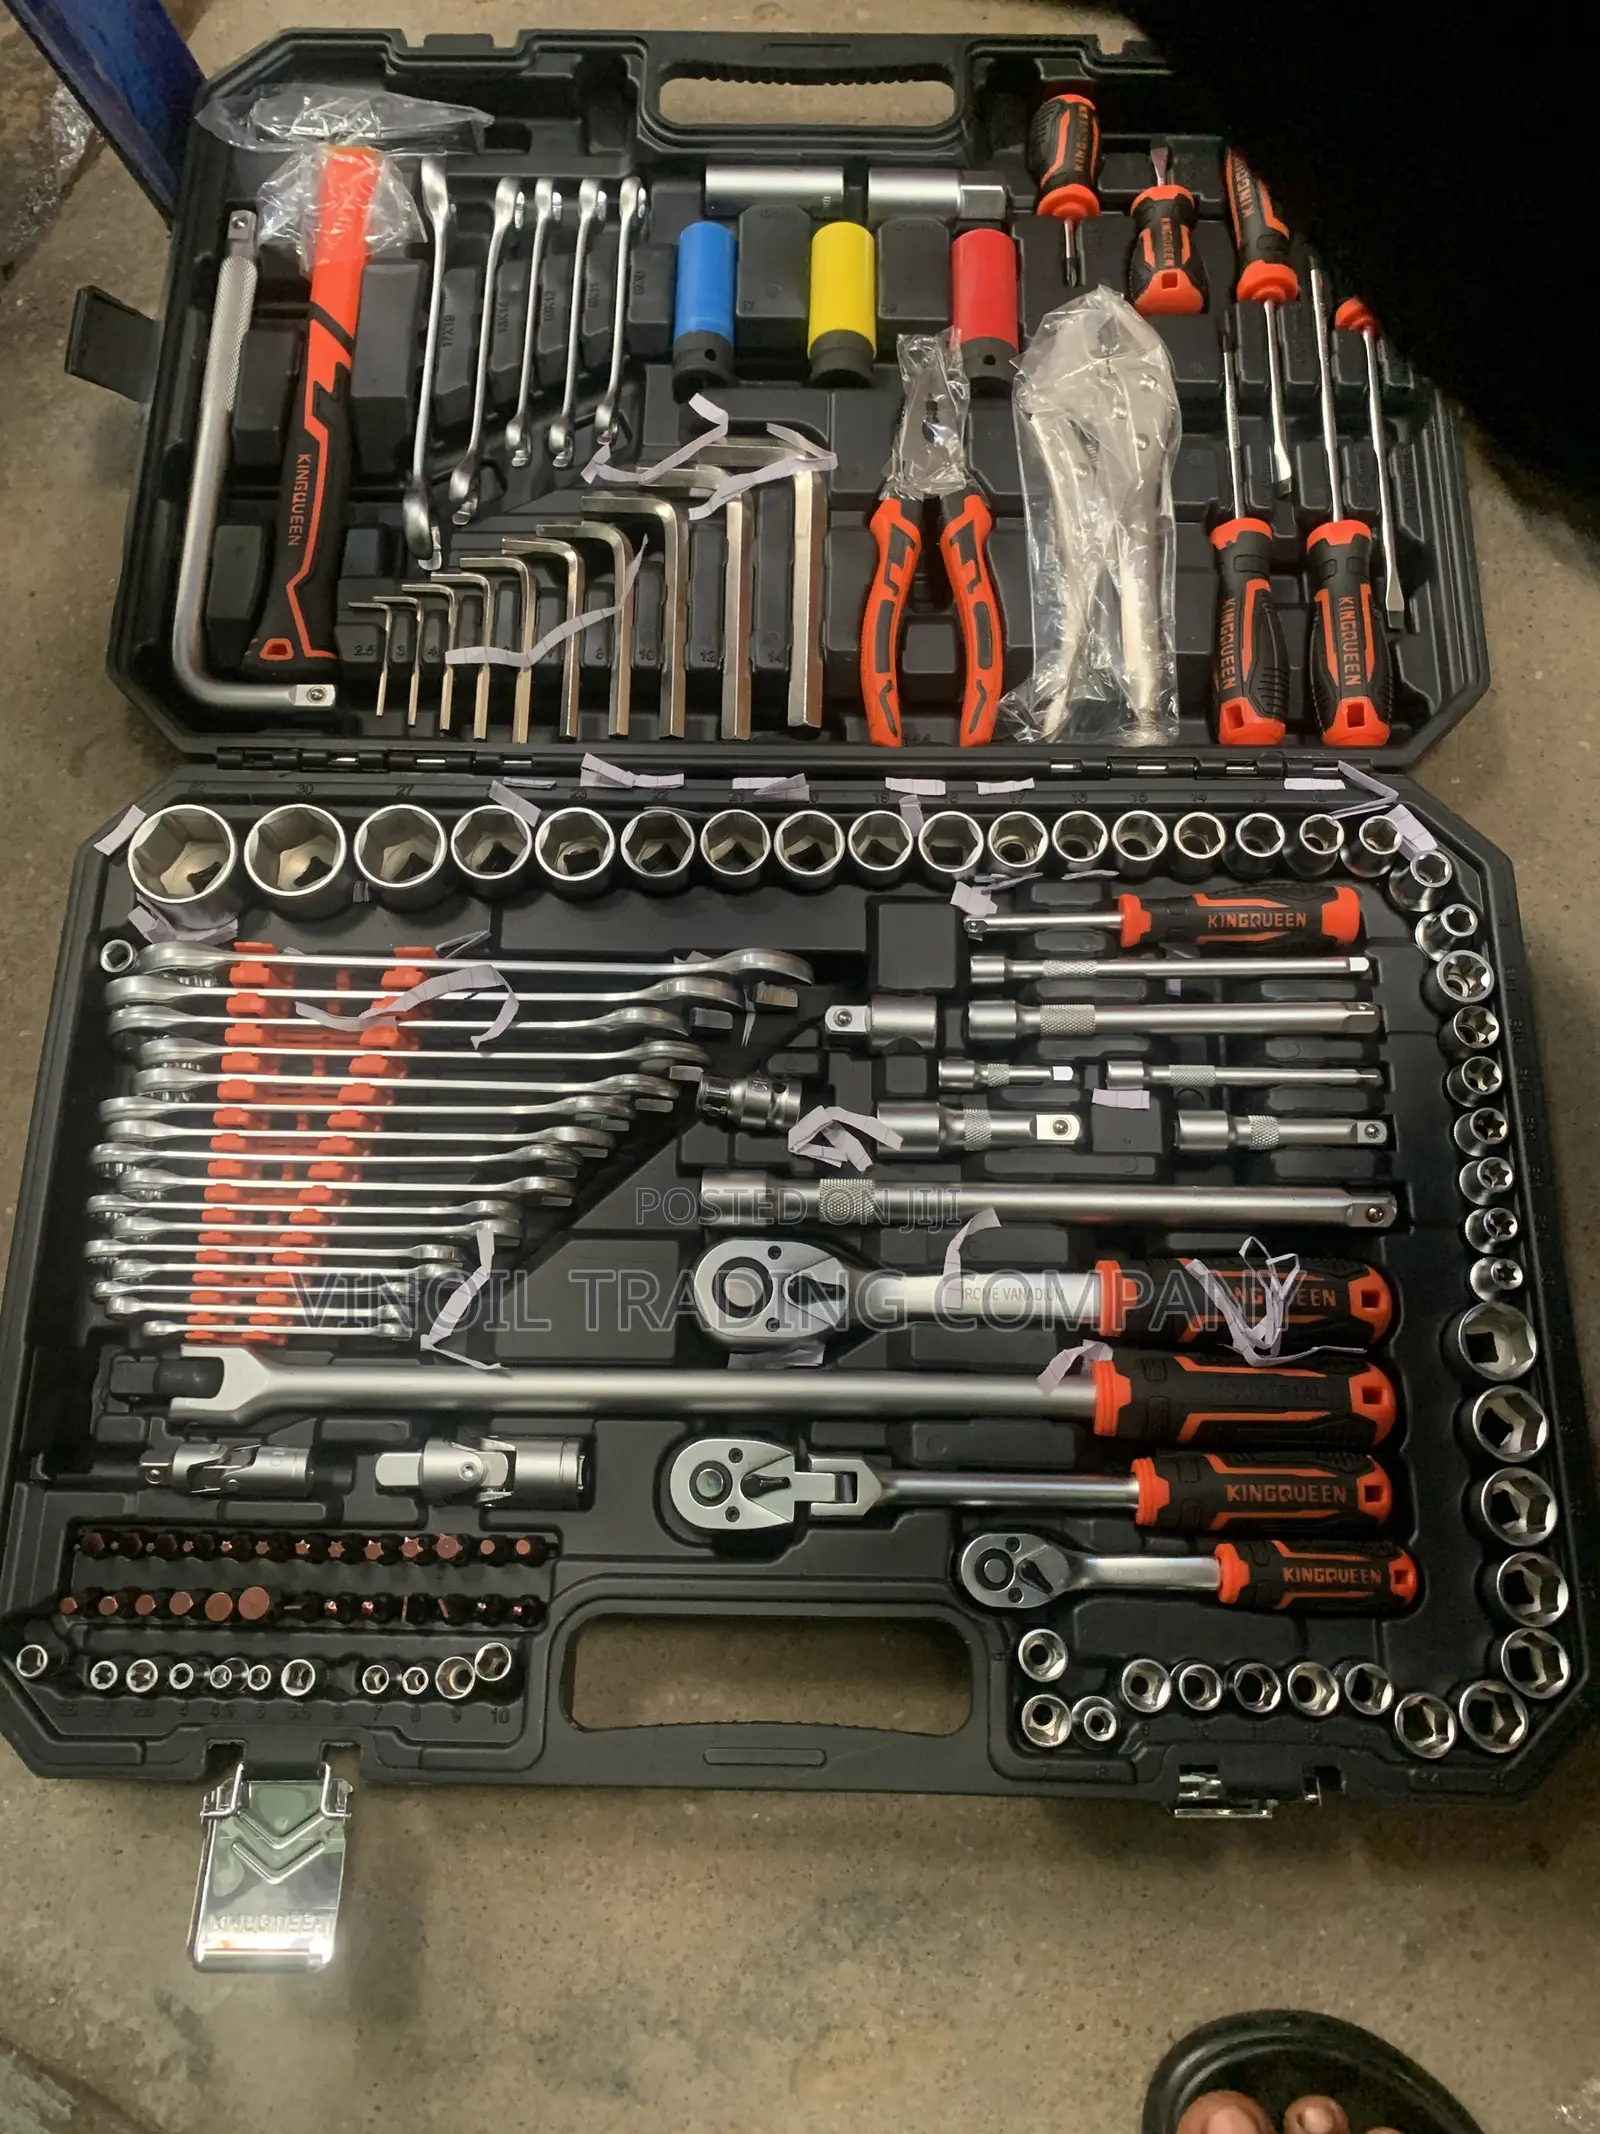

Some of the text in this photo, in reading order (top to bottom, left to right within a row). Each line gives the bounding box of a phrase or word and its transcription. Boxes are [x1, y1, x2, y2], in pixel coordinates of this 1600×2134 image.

[288, 453, 312, 546] KINGQUEEN
[1220, 597, 1237, 690] KINGQUEEN
[1338, 596, 1362, 686] KINGQUEEN
[1207, 912, 1307, 929] KINGQUEEN
[962, 1287, 999, 1301] ROME
[1226, 1484, 1347, 1504] KINGQUEEN
[1283, 1567, 1382, 1585] KINGQUEEN
